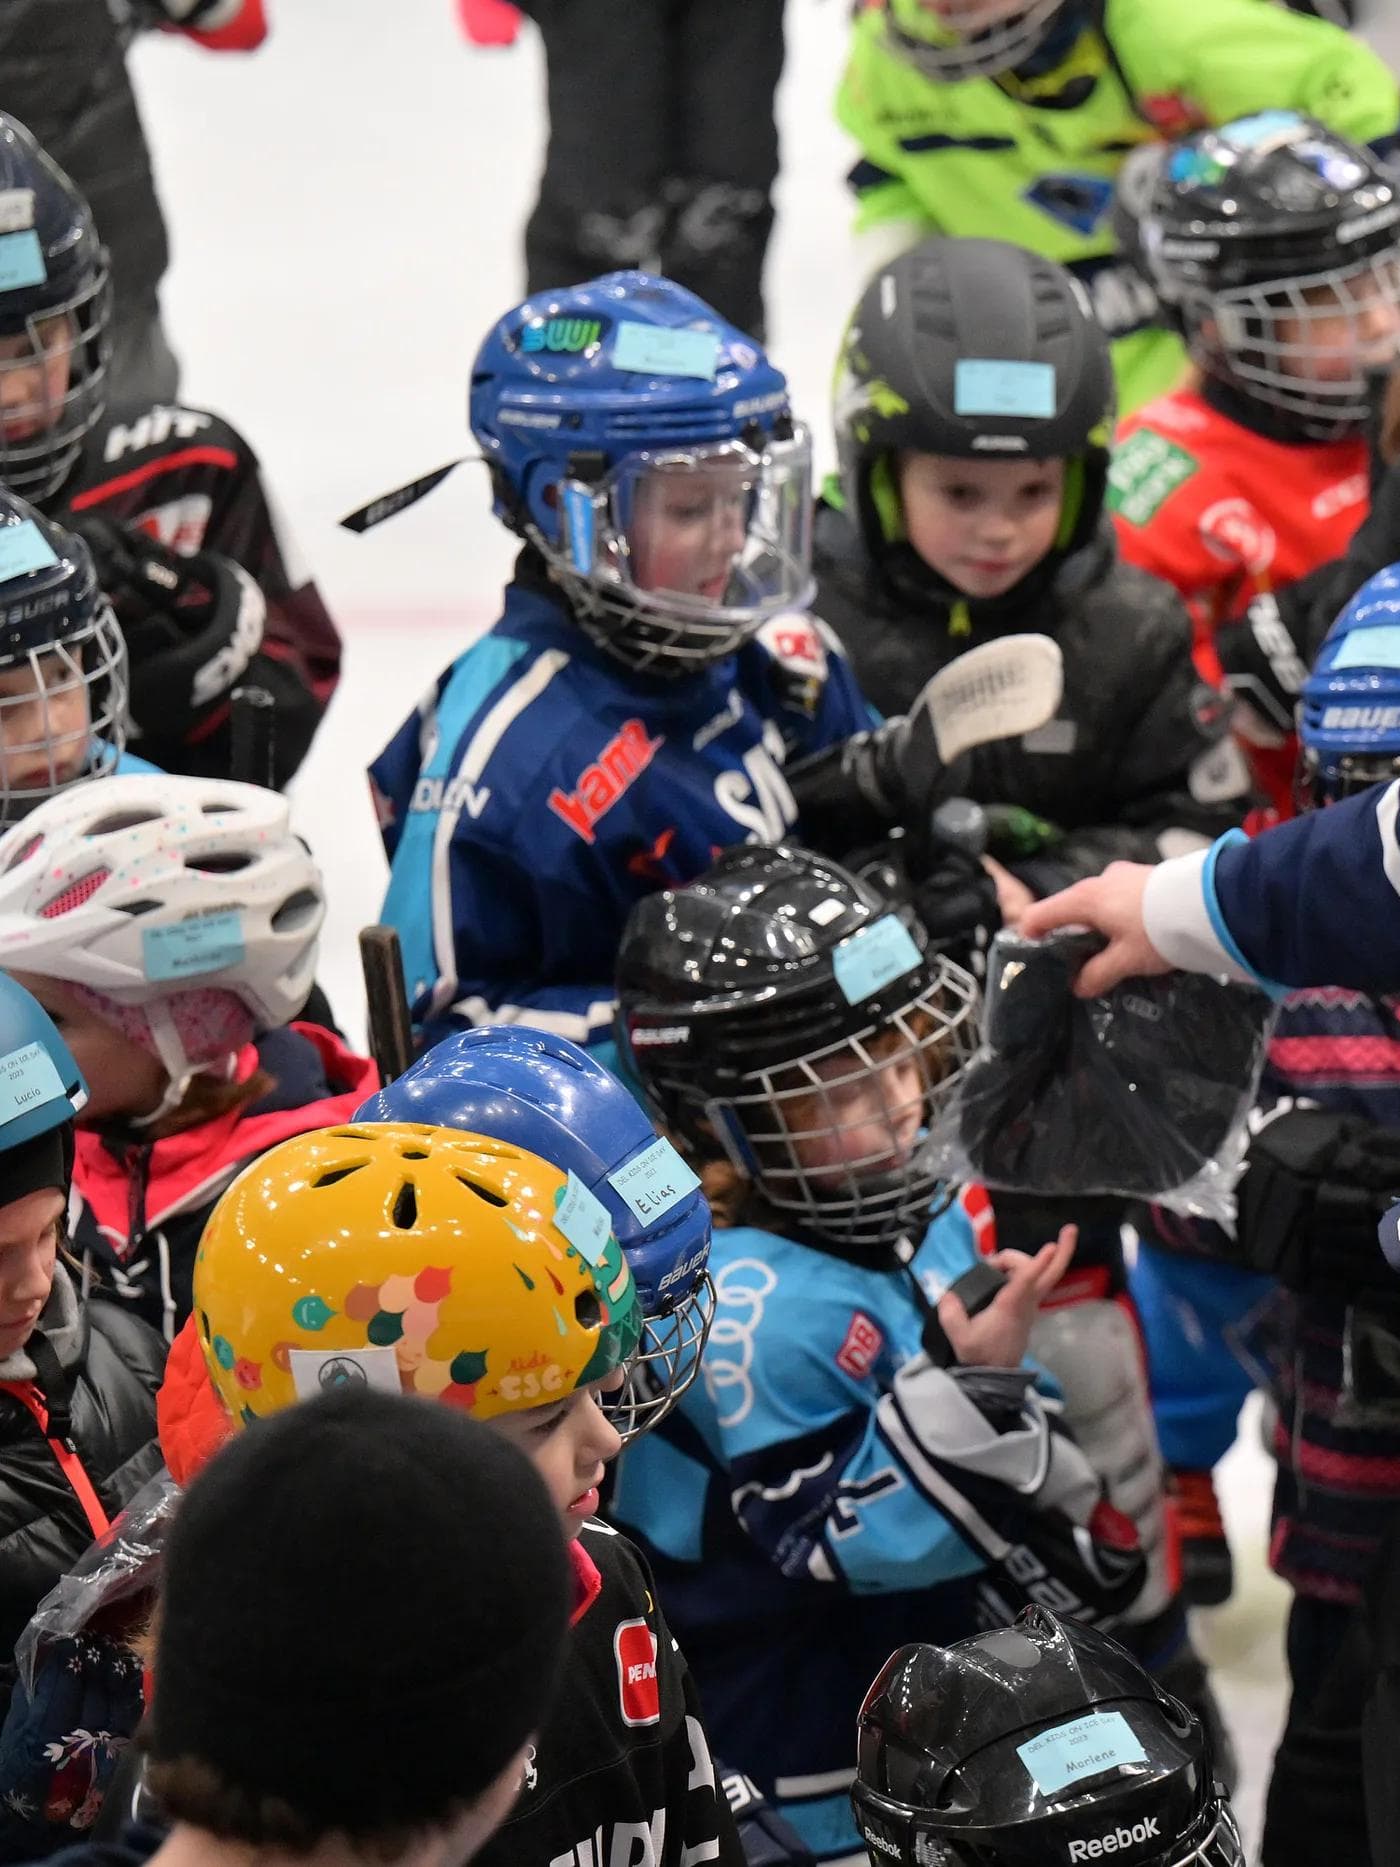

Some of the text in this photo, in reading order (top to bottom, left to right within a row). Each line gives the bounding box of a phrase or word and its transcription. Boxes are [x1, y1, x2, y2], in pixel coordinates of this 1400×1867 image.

[14, 1087, 41, 1105] Lucio
[635, 1184, 676, 1214] Elias
[657, 1241, 710, 1291] BAUER
[627, 1661, 656, 1684] PEN
[1065, 1748, 1117, 1773] Marlene
[864, 1826, 902, 1860] Reebok
[1068, 1816, 1161, 1864] Reebok
